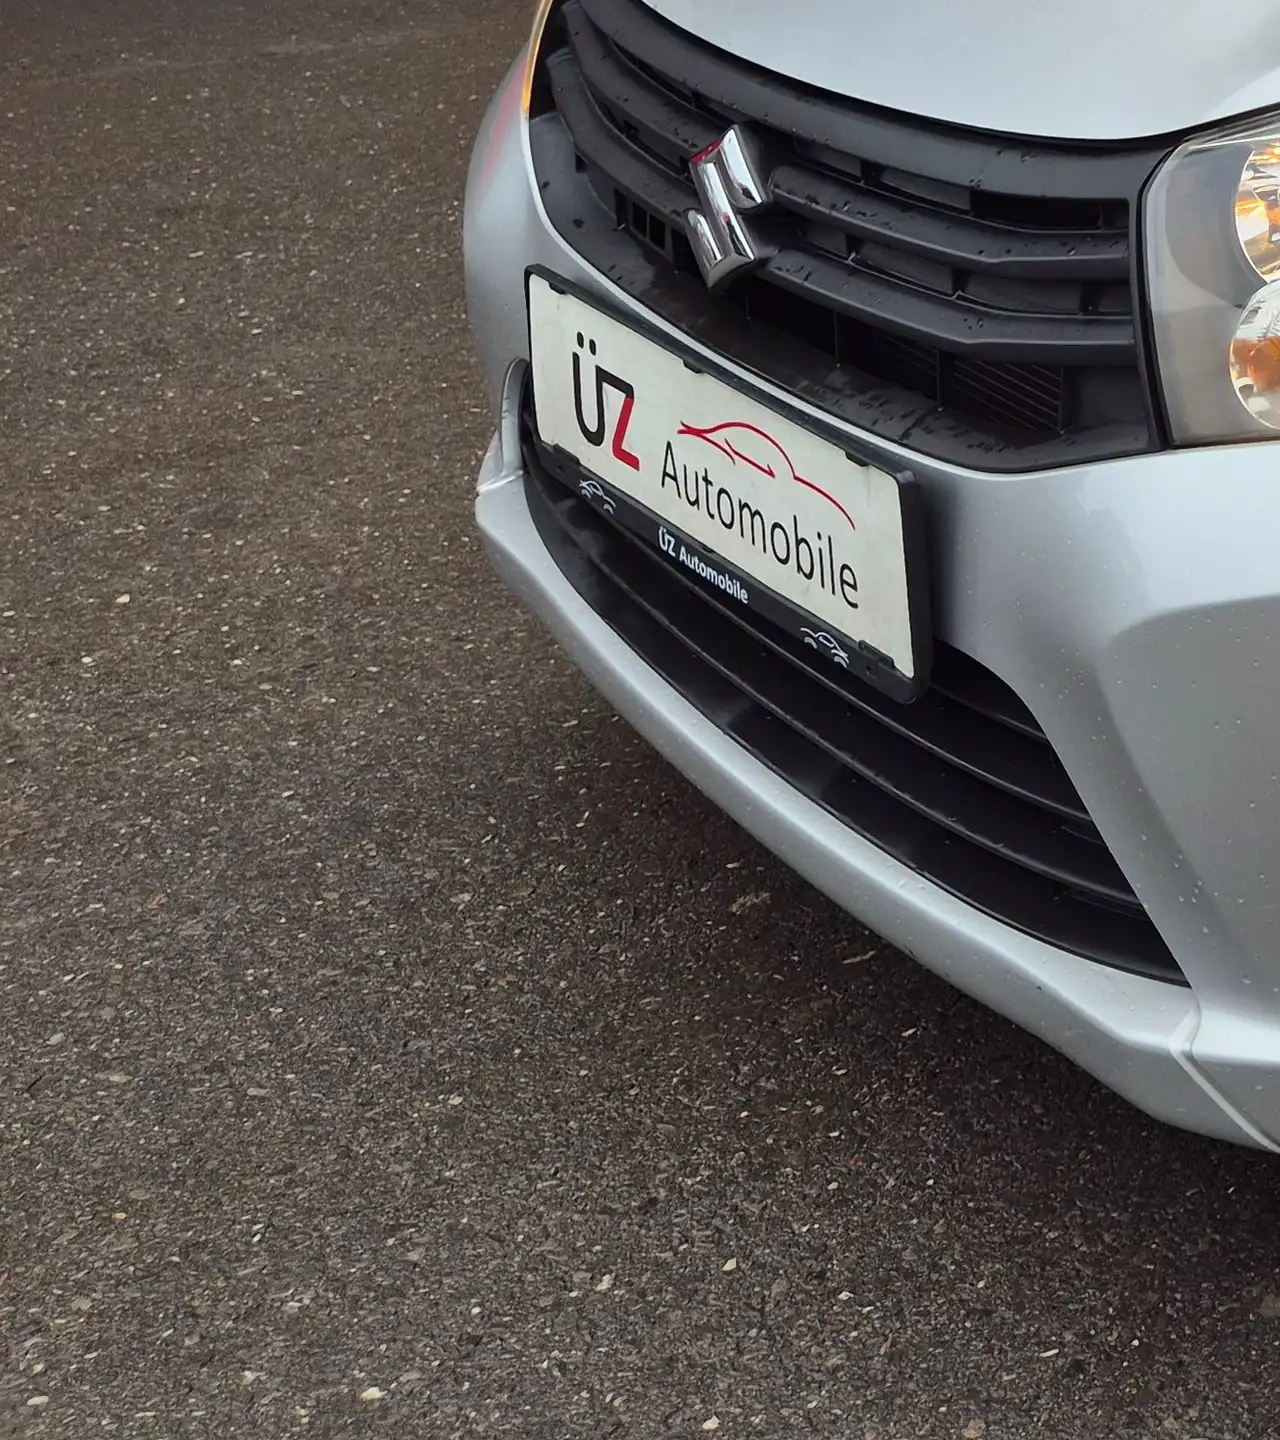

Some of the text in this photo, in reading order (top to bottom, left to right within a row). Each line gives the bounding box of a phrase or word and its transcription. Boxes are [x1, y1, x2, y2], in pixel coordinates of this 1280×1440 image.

[571, 331, 859, 610] ÜZ Automobile
[658, 525, 749, 605] ÜZ Automobile
